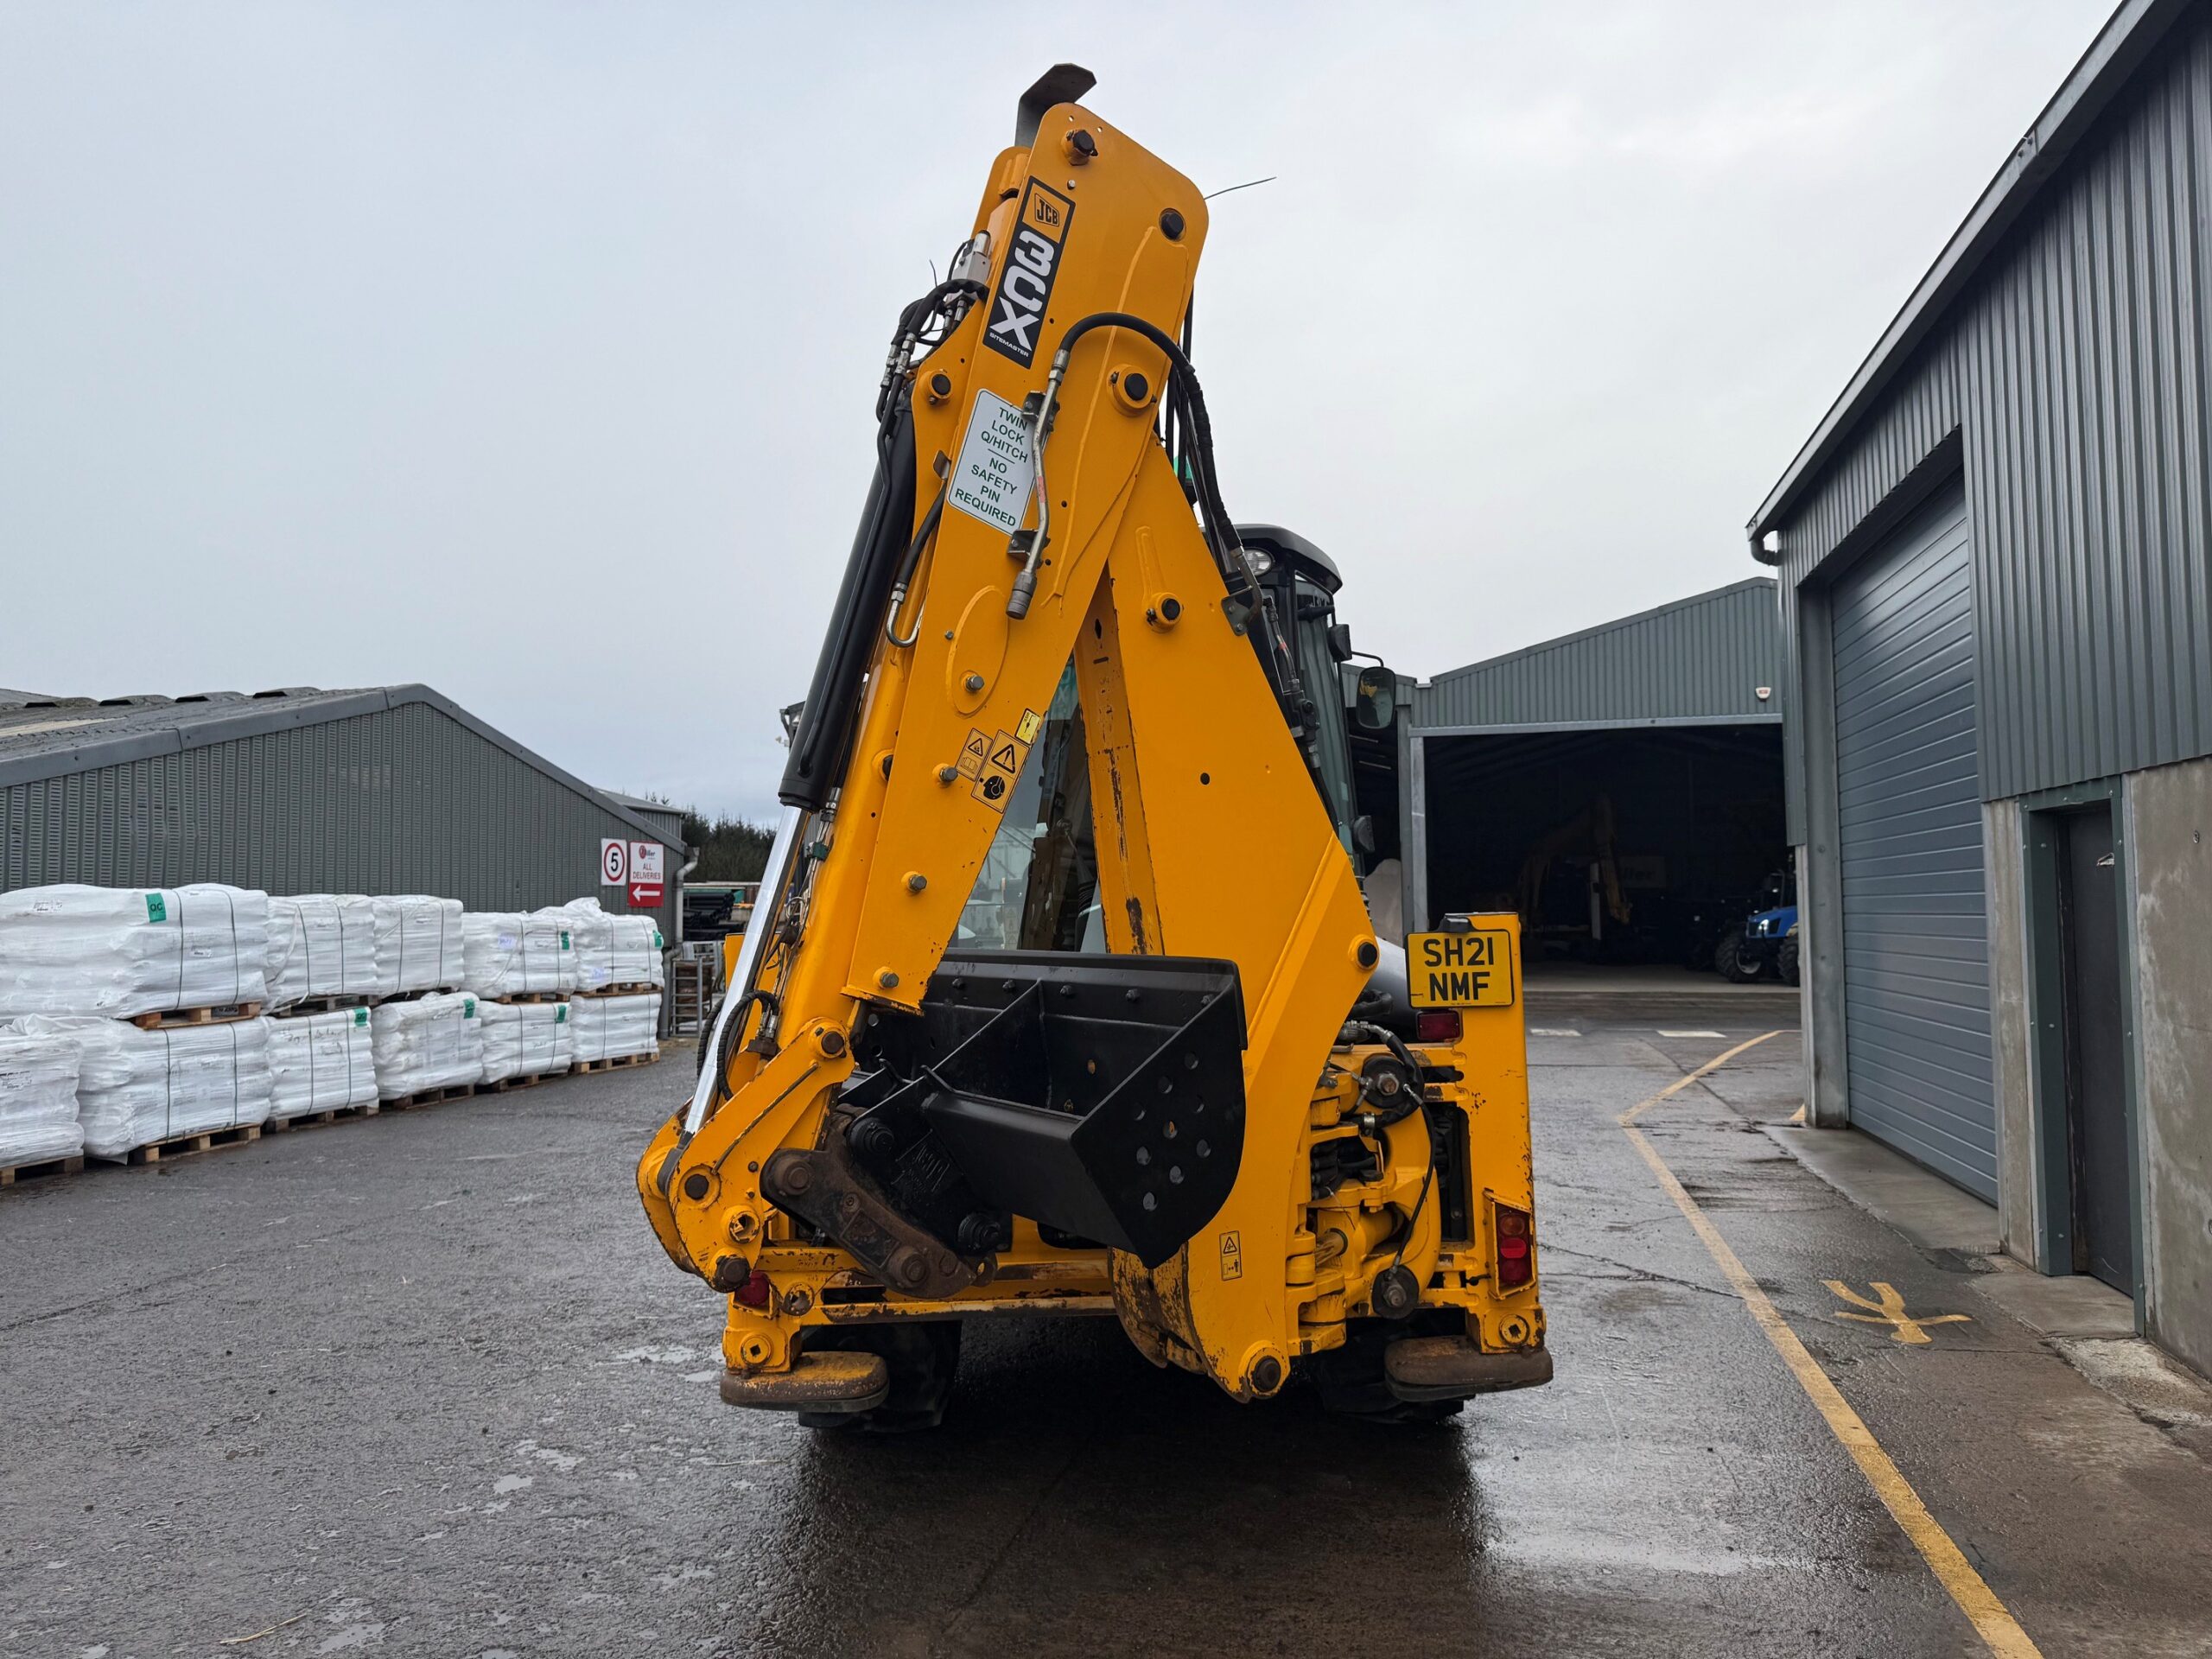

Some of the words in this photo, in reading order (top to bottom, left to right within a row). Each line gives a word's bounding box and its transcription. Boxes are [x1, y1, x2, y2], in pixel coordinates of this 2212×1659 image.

[1037, 198, 1058, 225] JCB
[990, 230, 1054, 351] 3CX
[989, 332, 1029, 358] SITEMASTER
[999, 407, 1027, 431] TWIN
[991, 420, 1026, 445] LOCK
[981, 430, 1028, 463] Q/HITCH
[989, 457, 1007, 474] NO
[971, 464, 1018, 495] SAFETY
[955, 487, 1016, 526] REQUIRED
[980, 485, 1001, 503] PIN
[611, 852, 619, 872] 5
[632, 871, 661, 880] DELIVERIES
[1423, 937, 1494, 967] SH21
[1429, 971, 1491, 1001] NMF
